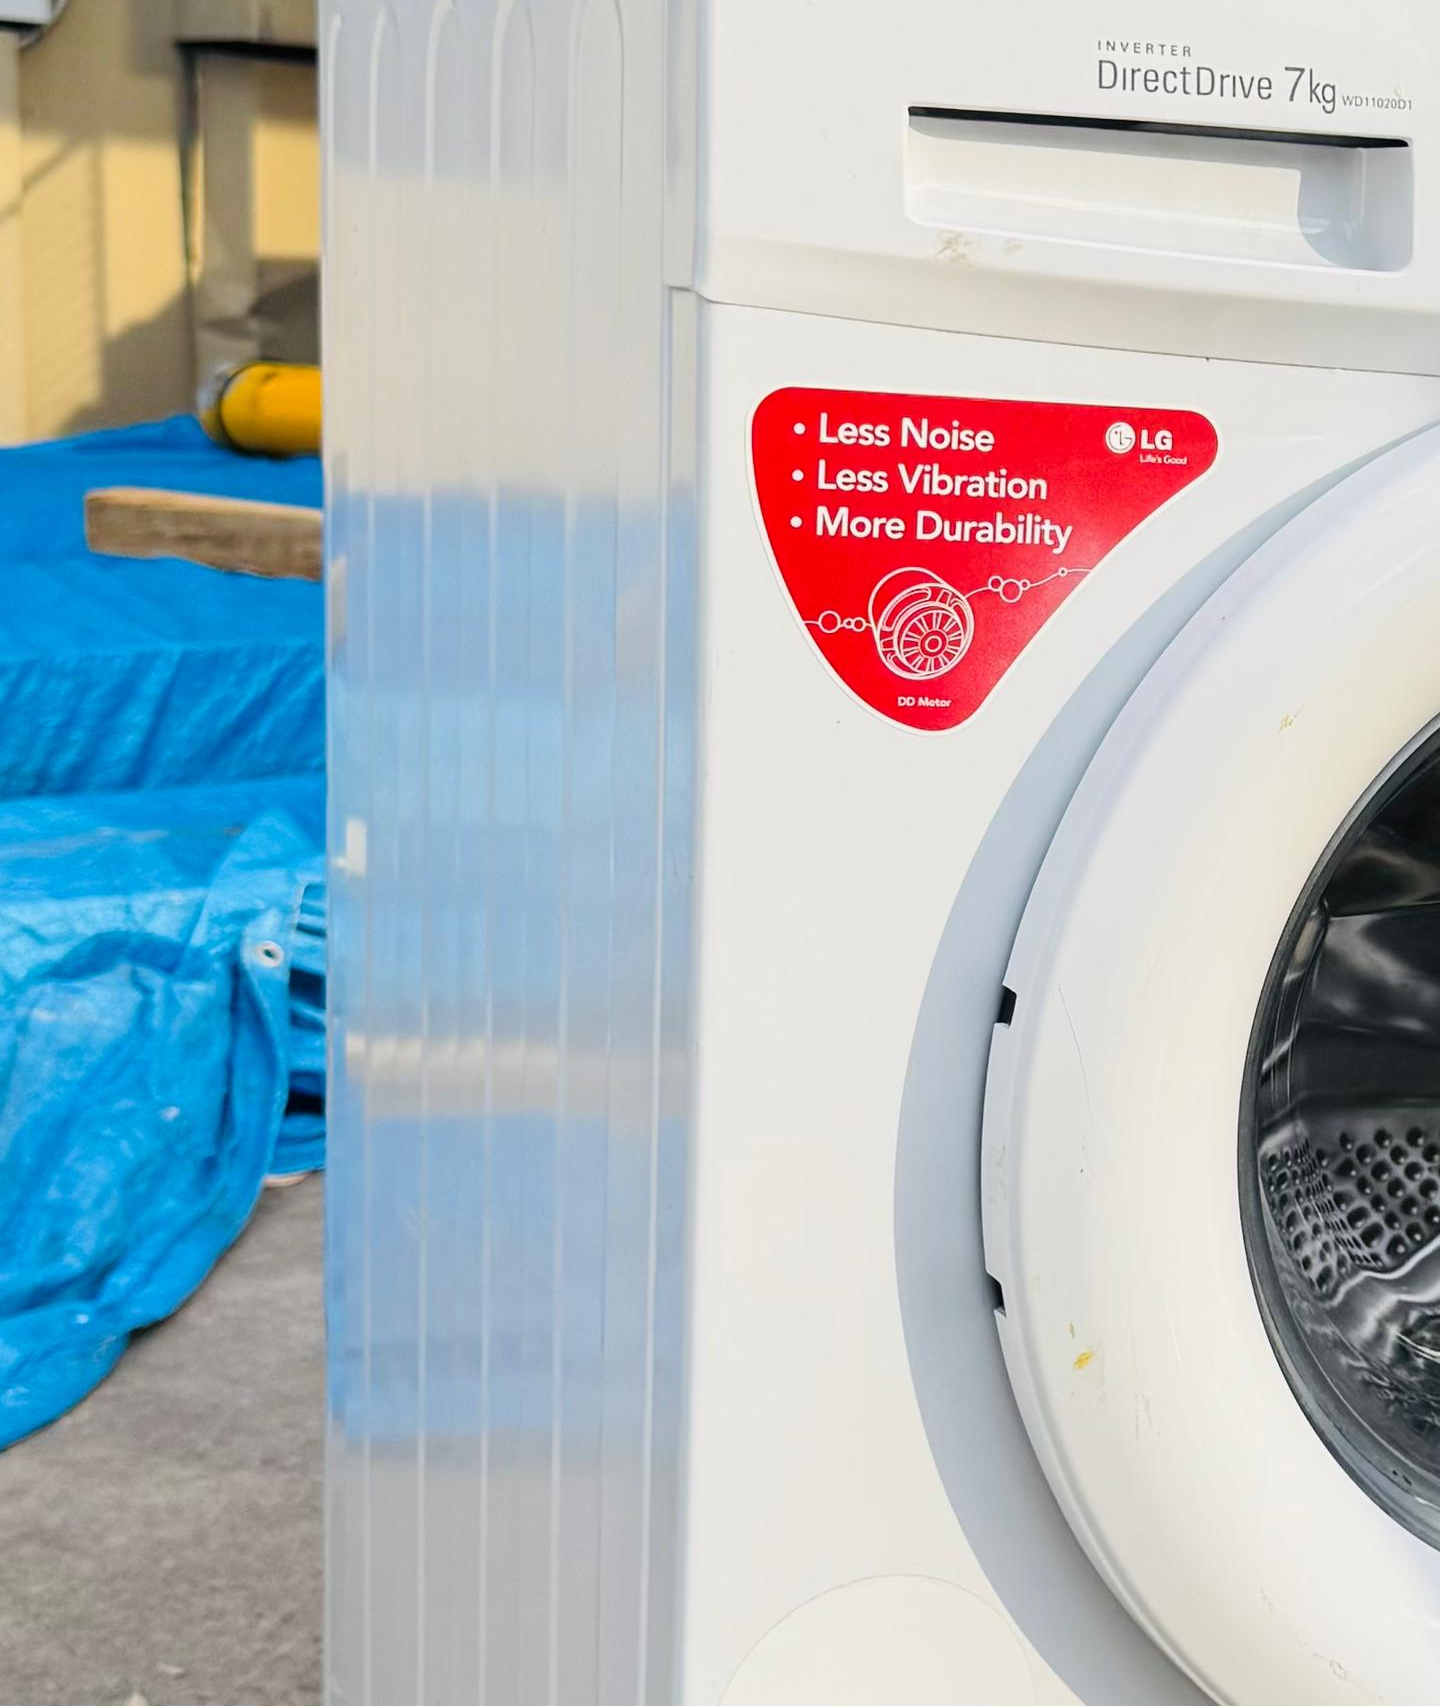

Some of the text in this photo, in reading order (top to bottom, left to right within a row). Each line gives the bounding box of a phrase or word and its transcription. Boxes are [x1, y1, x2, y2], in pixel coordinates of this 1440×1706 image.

[1098, 40, 1192, 57] INVERTER
[1342, 95, 1413, 110] WD11020D1
[819, 412, 995, 452] Less Noise
[1141, 429, 1173, 451] LG
[1140, 454, 1187, 465] Life's Good
[818, 459, 1047, 500] Less Vibration
[816, 505, 1073, 555] More Durability
[897, 696, 952, 707] DD Motor
